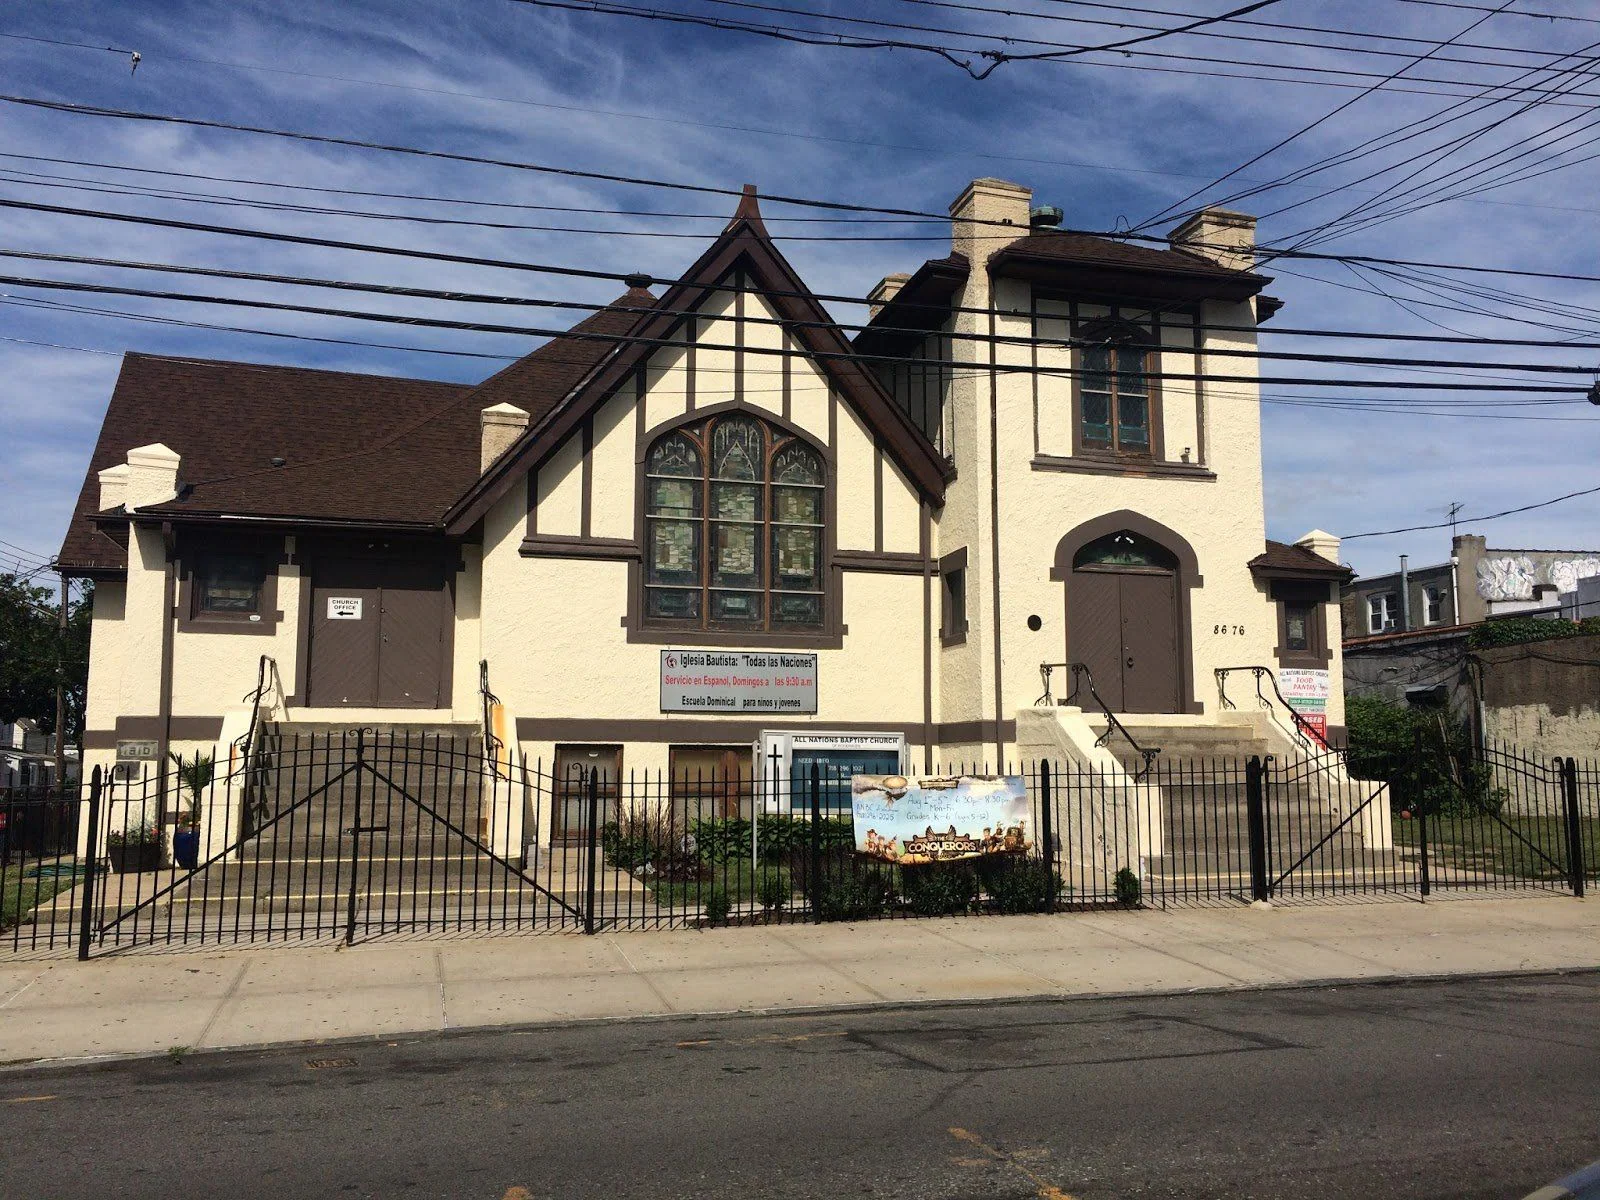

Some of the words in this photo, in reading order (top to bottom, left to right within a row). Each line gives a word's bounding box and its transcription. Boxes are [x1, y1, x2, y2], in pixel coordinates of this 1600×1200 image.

[680, 653, 705, 668] Iglesia
[706, 654, 738, 666] Bautista:
[742, 655, 766, 667] "Todas
[768, 656, 778, 667] las
[780, 656, 815, 668] Naciones"
[665, 675, 692, 685] Servicio
[693, 677, 702, 685] en
[732, 675, 763, 688] Domingos
[764, 678, 769, 686] a
[774, 676, 784, 686] las
[785, 676, 799, 687] 9:30
[1293, 684, 1316, 692] PANTRY
[682, 695, 706, 706] Escuela
[707, 696, 736, 706] Dominical
[743, 699, 756, 708] para
[757, 697, 773, 707] ninos
[778, 697, 801, 709] jovenes
[908, 793, 922, 809] Aug
[906, 811, 930, 820] Grades
[908, 841, 977, 853] CONQUERORS
